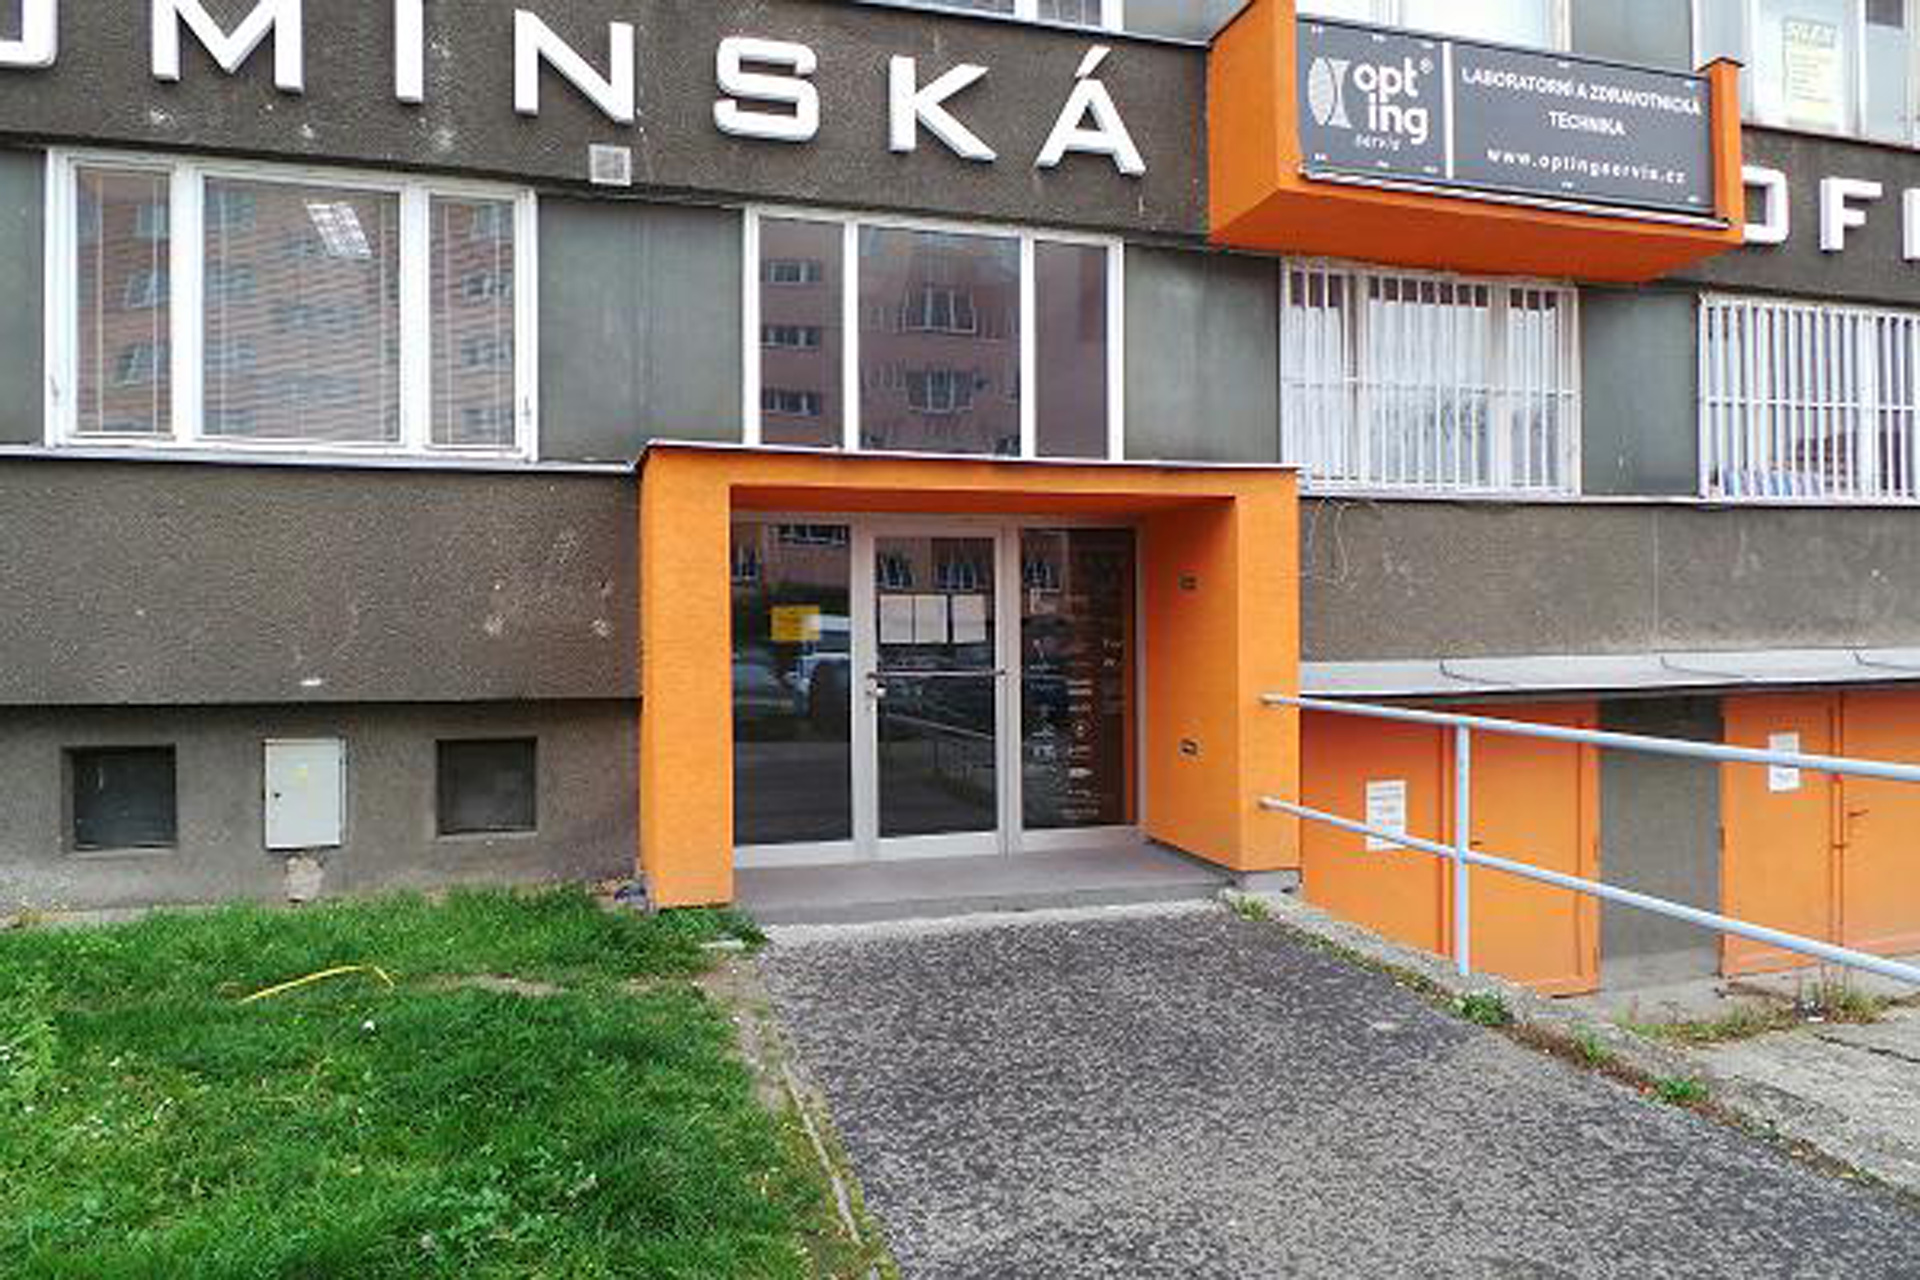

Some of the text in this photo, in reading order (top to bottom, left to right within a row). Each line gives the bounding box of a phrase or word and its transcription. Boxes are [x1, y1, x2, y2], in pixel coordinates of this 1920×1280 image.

[1577, 82, 1588, 100] A
[1368, 92, 1429, 145] ing
[1548, 110, 1626, 136] TECHNIKA
[1487, 148, 1687, 184] www.optingservis.cz
